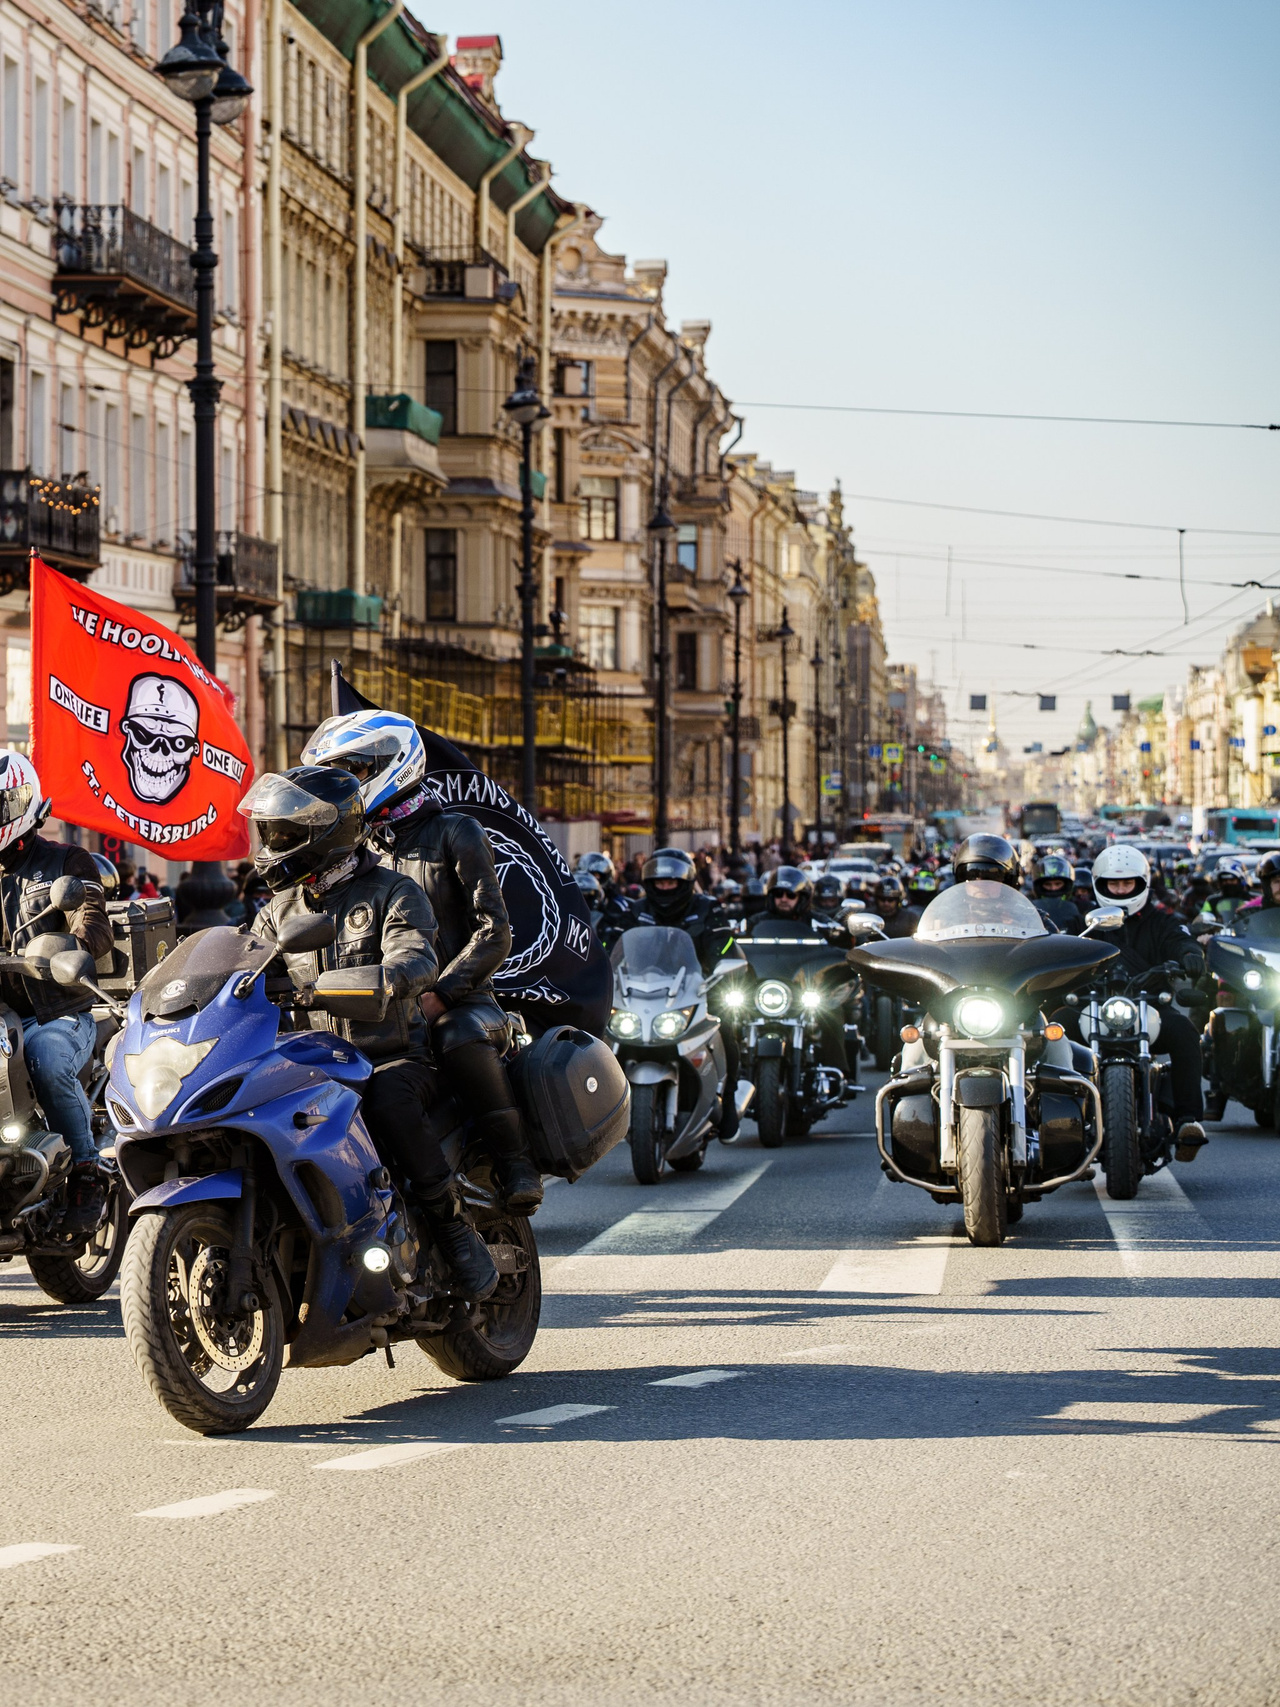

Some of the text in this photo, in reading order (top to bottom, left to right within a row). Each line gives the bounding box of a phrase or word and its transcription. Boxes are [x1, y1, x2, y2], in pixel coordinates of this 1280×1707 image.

[55, 683, 75, 711] ONE
[206, 748, 230, 772] ONE
[396, 766, 413, 785] SHOEI
[81, 761, 218, 844] ST. PETERSBURG
[566, 918, 590, 954] MC
[149, 1027, 180, 1038] SUZUKI
